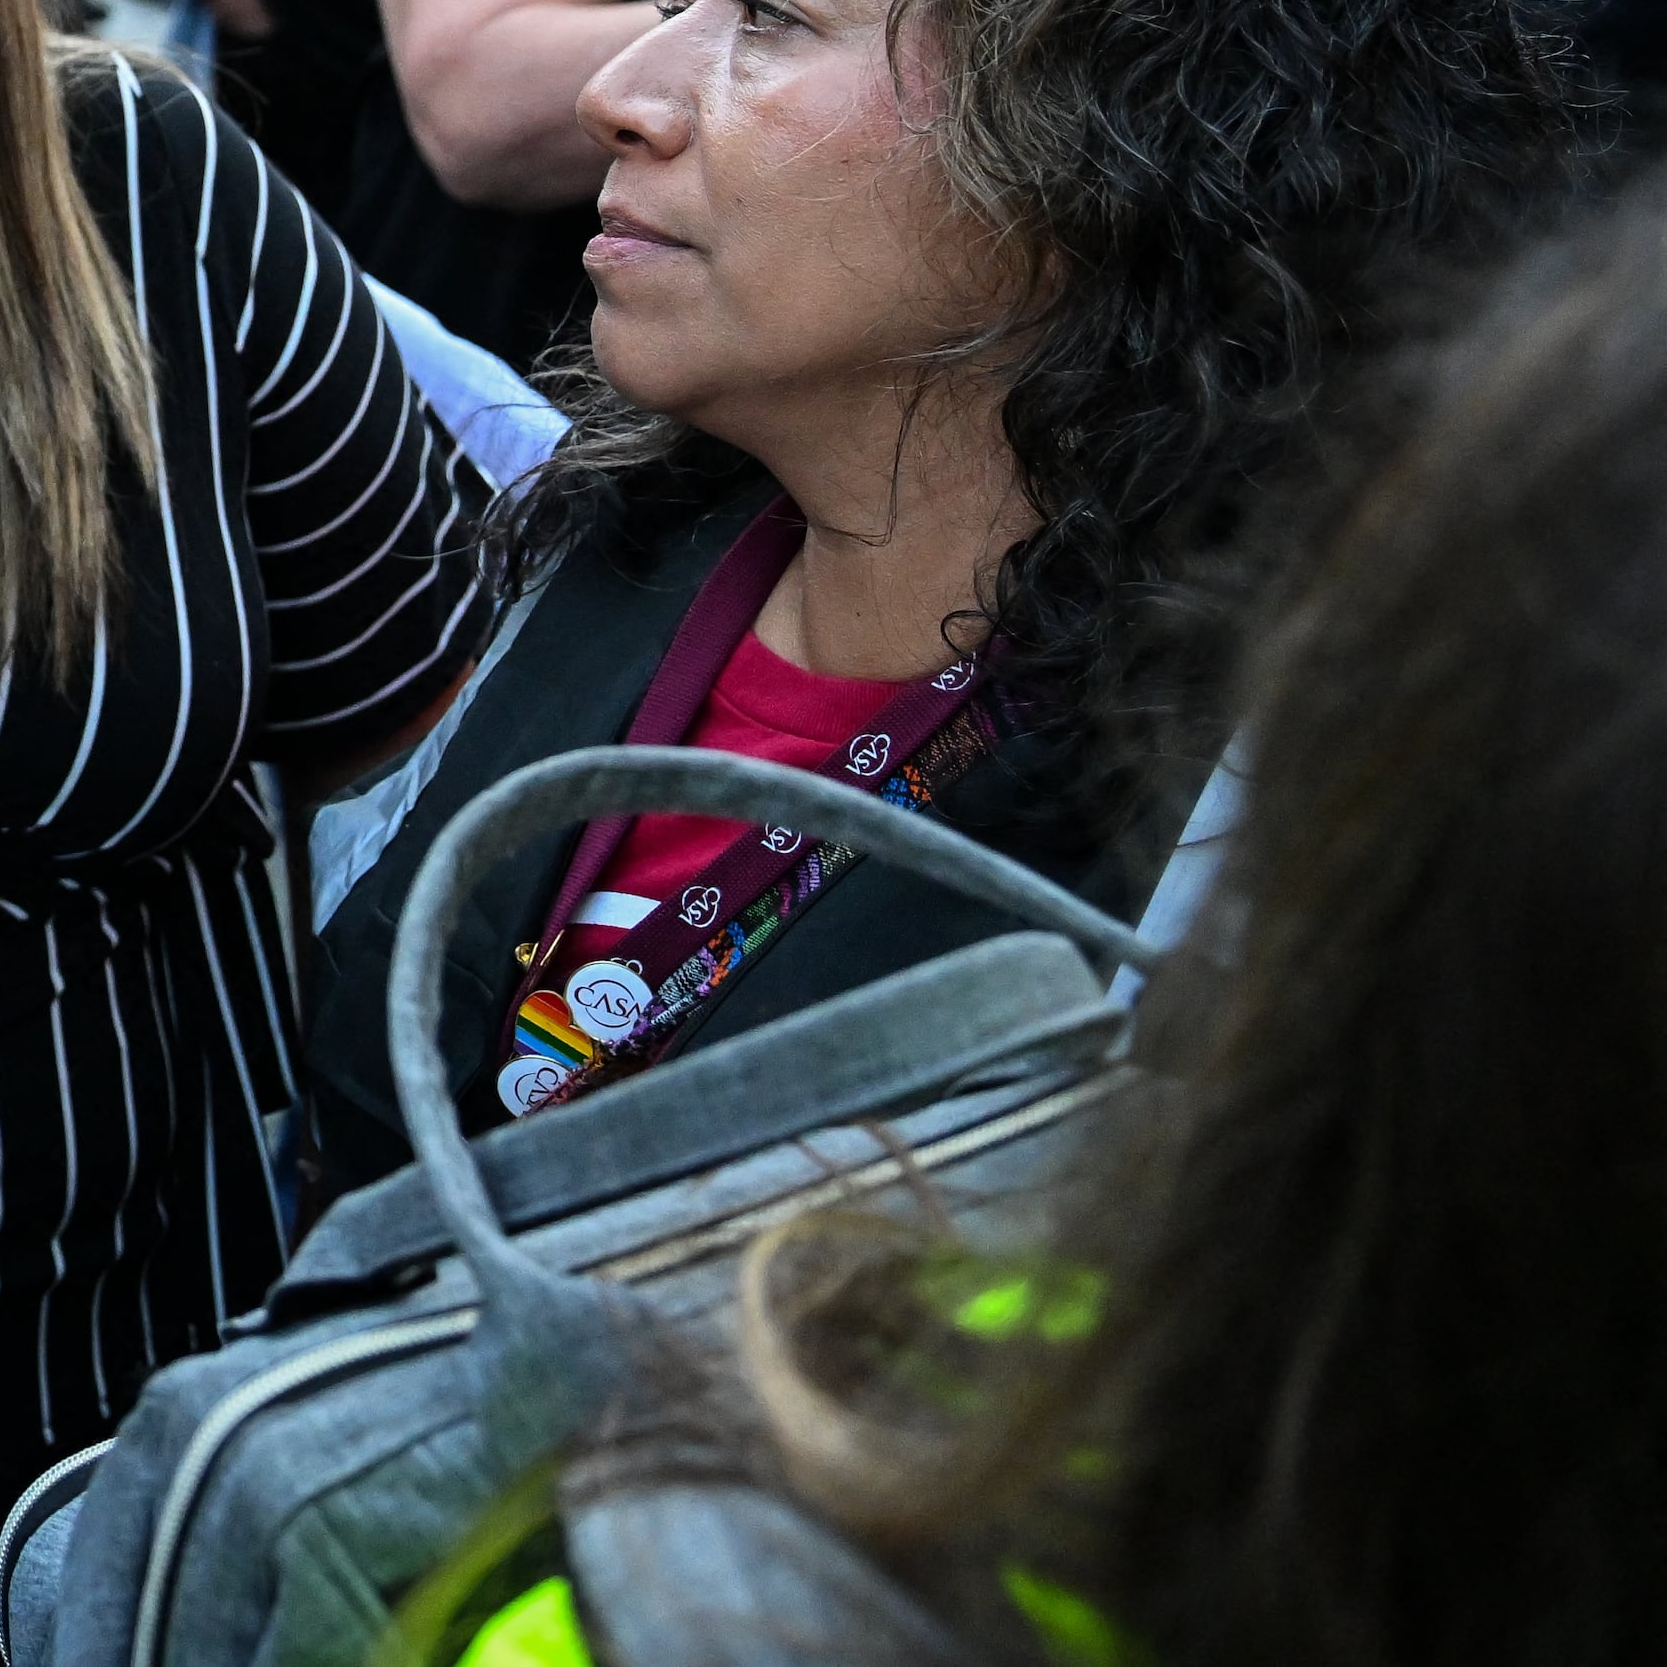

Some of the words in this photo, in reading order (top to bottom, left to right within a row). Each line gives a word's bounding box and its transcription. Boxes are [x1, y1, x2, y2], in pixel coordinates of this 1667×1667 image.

[931, 652, 977, 691] ASA
[761, 825, 794, 852] ASA
[525, 1066, 560, 1109] CAS
